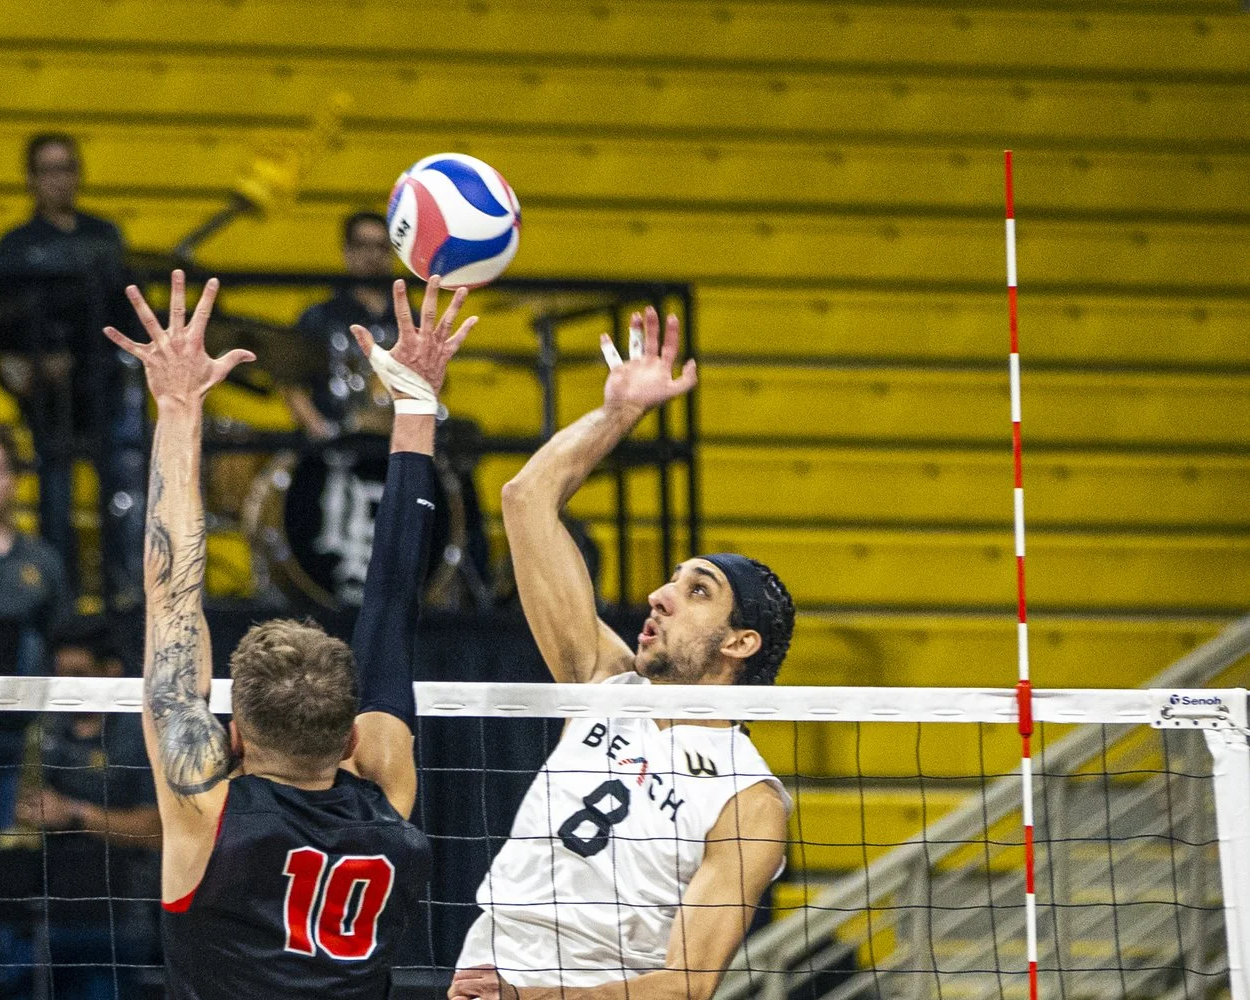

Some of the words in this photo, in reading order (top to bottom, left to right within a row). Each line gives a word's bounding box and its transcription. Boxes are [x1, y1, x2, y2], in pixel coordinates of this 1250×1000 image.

[1181, 696, 1222, 706] Senoh
[582, 723, 685, 823] BEACH
[558, 779, 631, 859] 8
[282, 846, 395, 960] 10
